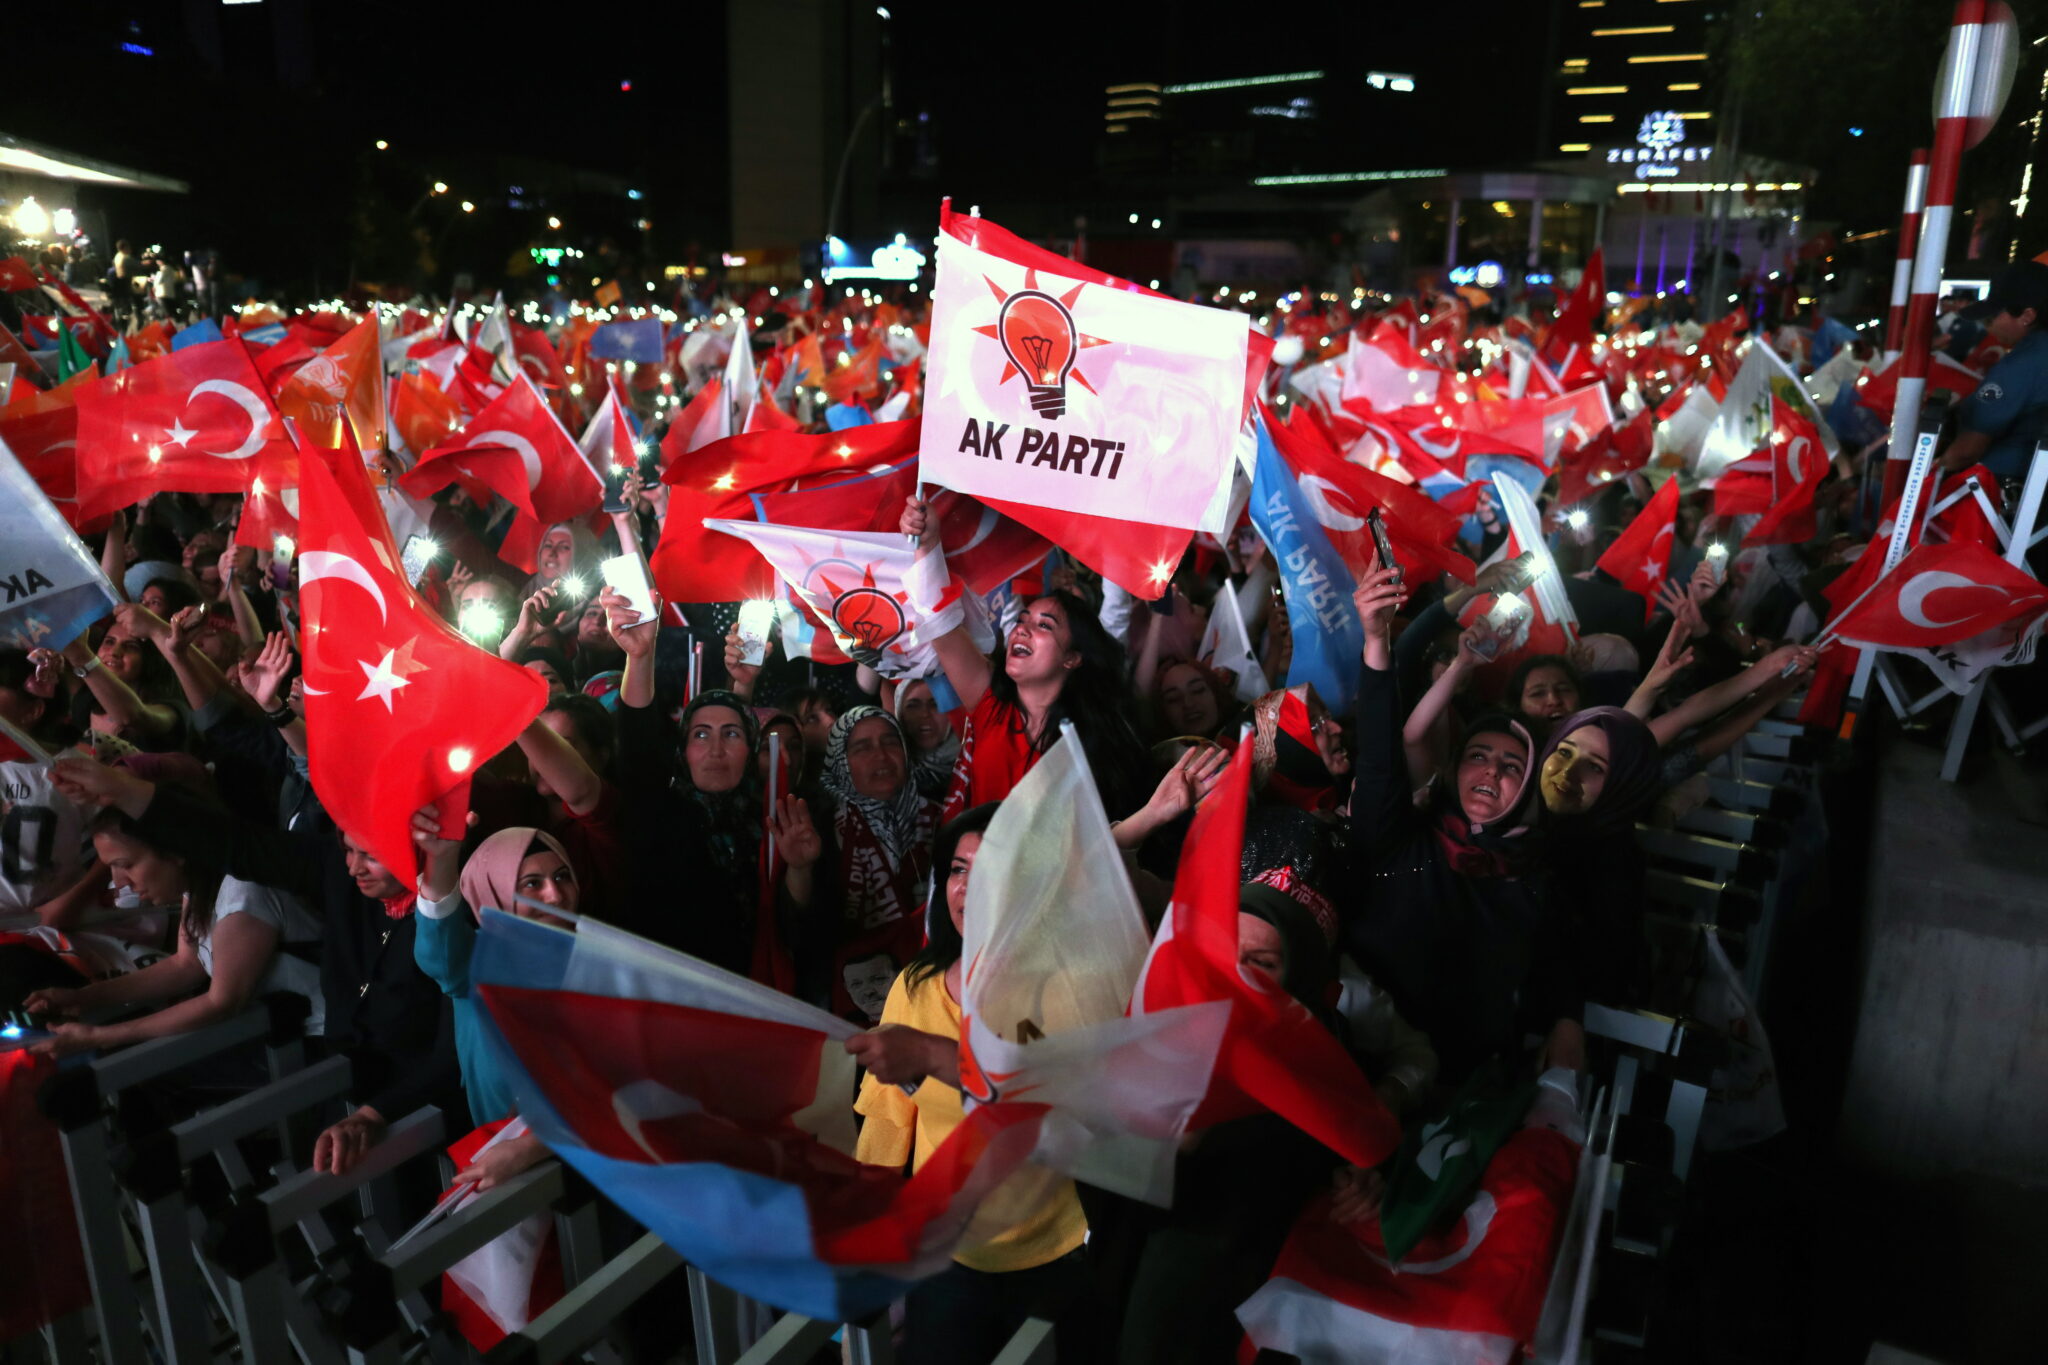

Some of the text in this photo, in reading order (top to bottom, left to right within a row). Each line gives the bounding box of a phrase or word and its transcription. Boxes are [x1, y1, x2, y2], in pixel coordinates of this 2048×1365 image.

[1606, 147, 1713, 162] ZERAFET
[958, 417, 1126, 480] AK PARTİ
[5, 783, 31, 800] KID
